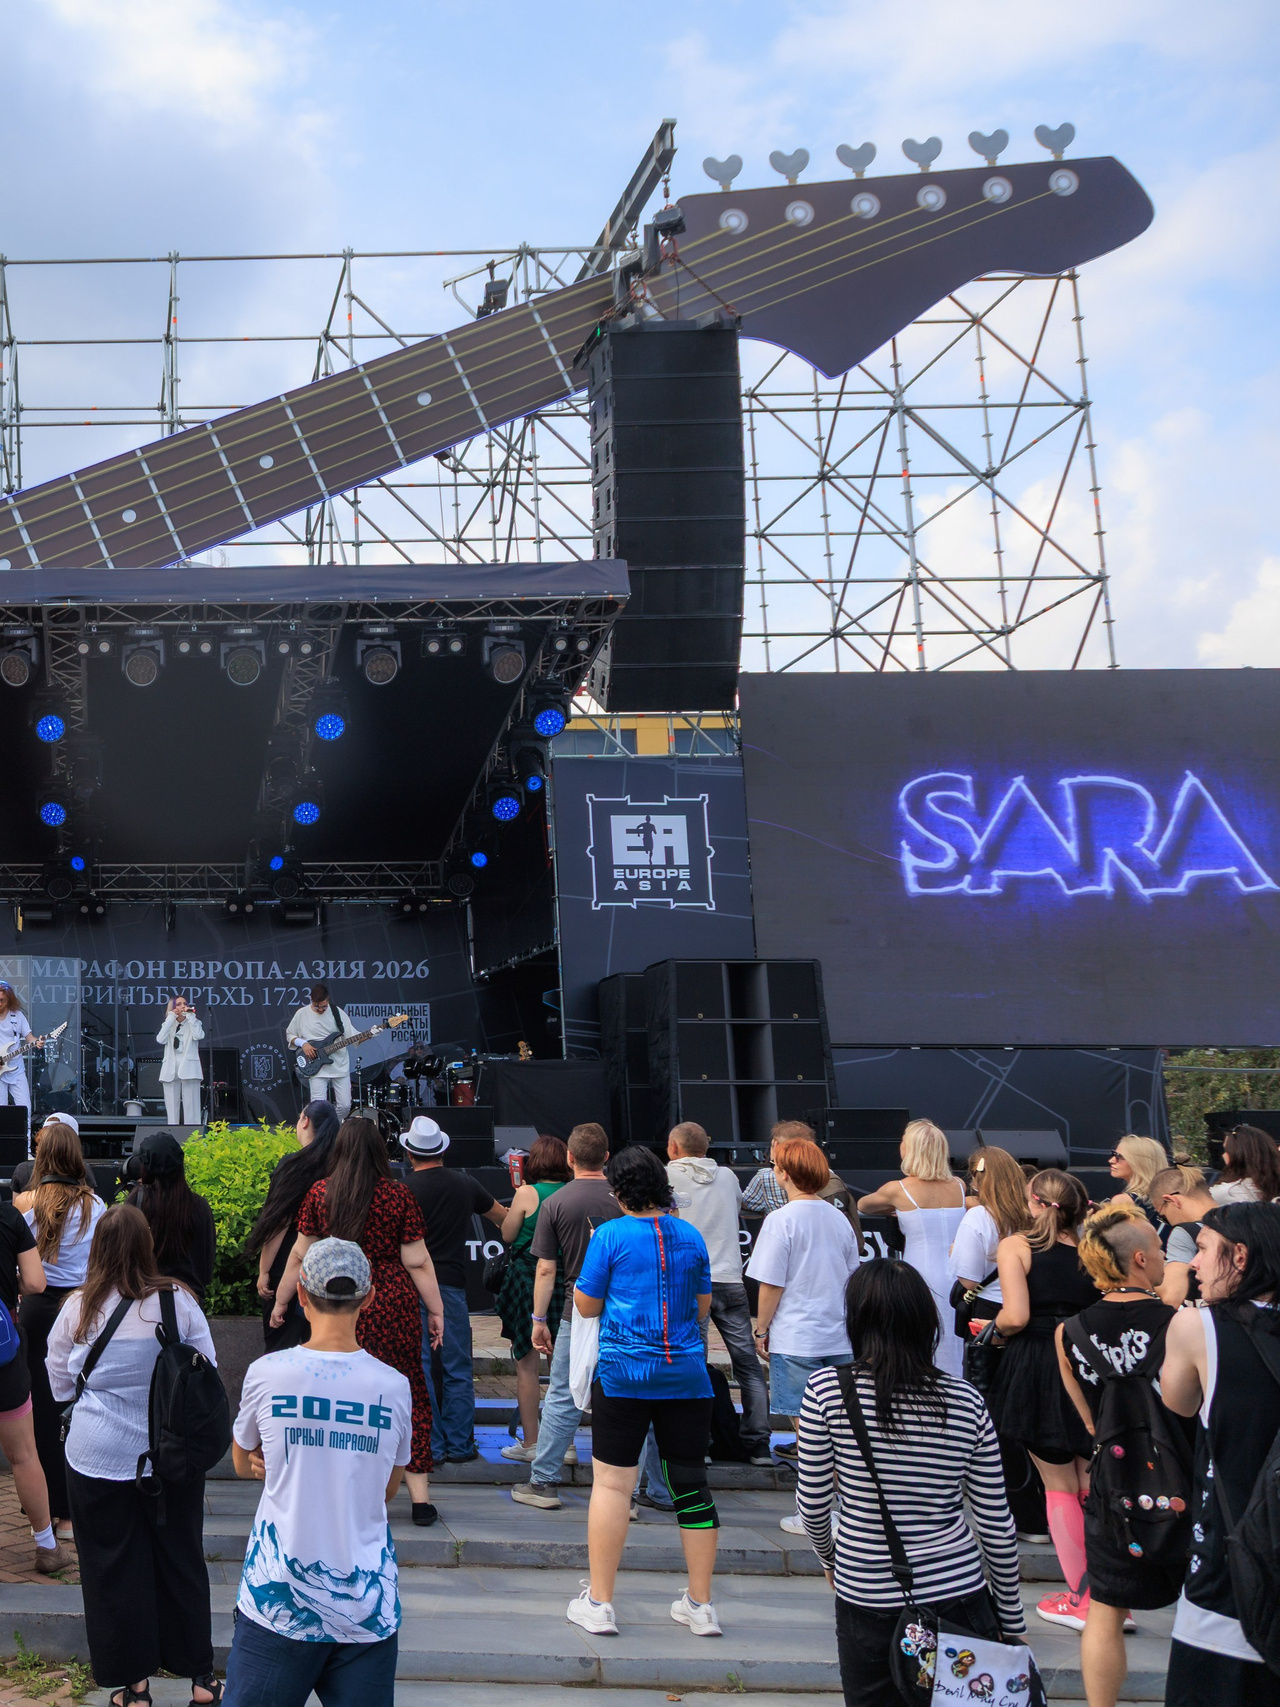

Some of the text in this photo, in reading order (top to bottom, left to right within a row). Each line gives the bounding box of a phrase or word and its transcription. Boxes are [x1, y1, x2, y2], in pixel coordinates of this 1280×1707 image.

[898, 769, 1280, 904] SARA
[613, 868, 691, 879] EUROPE
[613, 880, 692, 891] ASIA
[31, 959, 167, 980] МАРАФОН
[171, 959, 366, 980] ЕВРОПА-АЗИЯ
[371, 959, 430, 979] 2026
[262, 987, 312, 1006] 1723
[347, 1004, 429, 1018] НАЦИОНАЛЬНЫЕ
[382, 1017, 429, 1030] ПЕКТЫ
[271, 1395, 393, 1431] 2026
[284, 1426, 380, 1459] ГОРНЫЙ МАРАФОН
[934, 1679, 965, 1699] Devil
